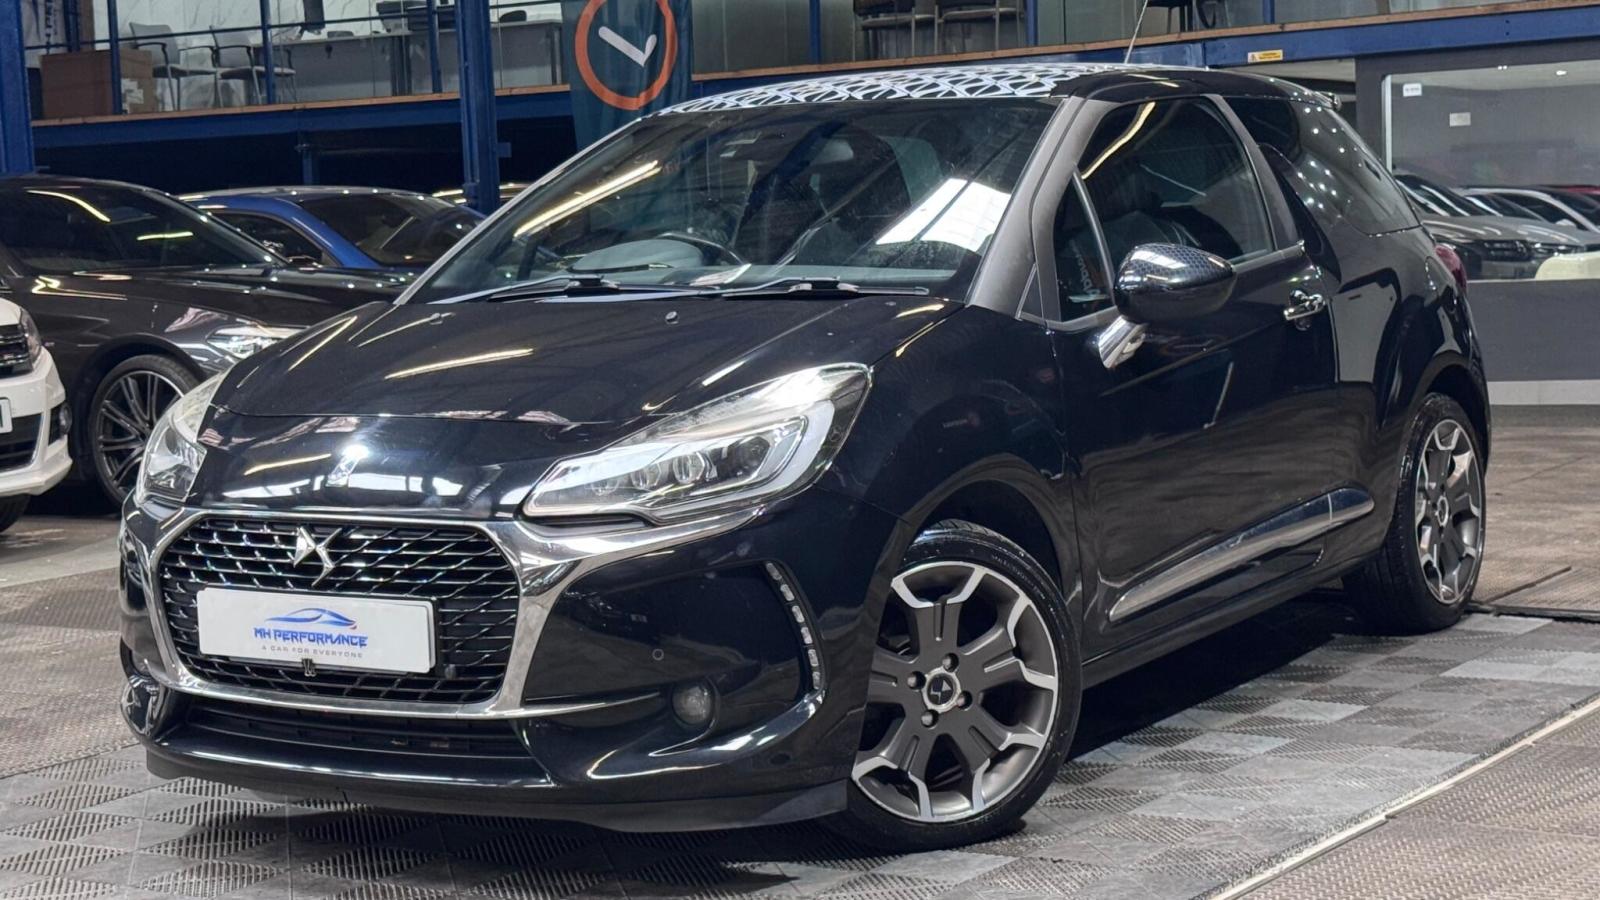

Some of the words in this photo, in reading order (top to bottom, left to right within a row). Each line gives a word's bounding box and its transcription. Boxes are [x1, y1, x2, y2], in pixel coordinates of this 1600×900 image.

[254, 627, 271, 639] MH
[273, 629, 368, 647] PERFORMANCE
[313, 649, 363, 658] EVERYONE
